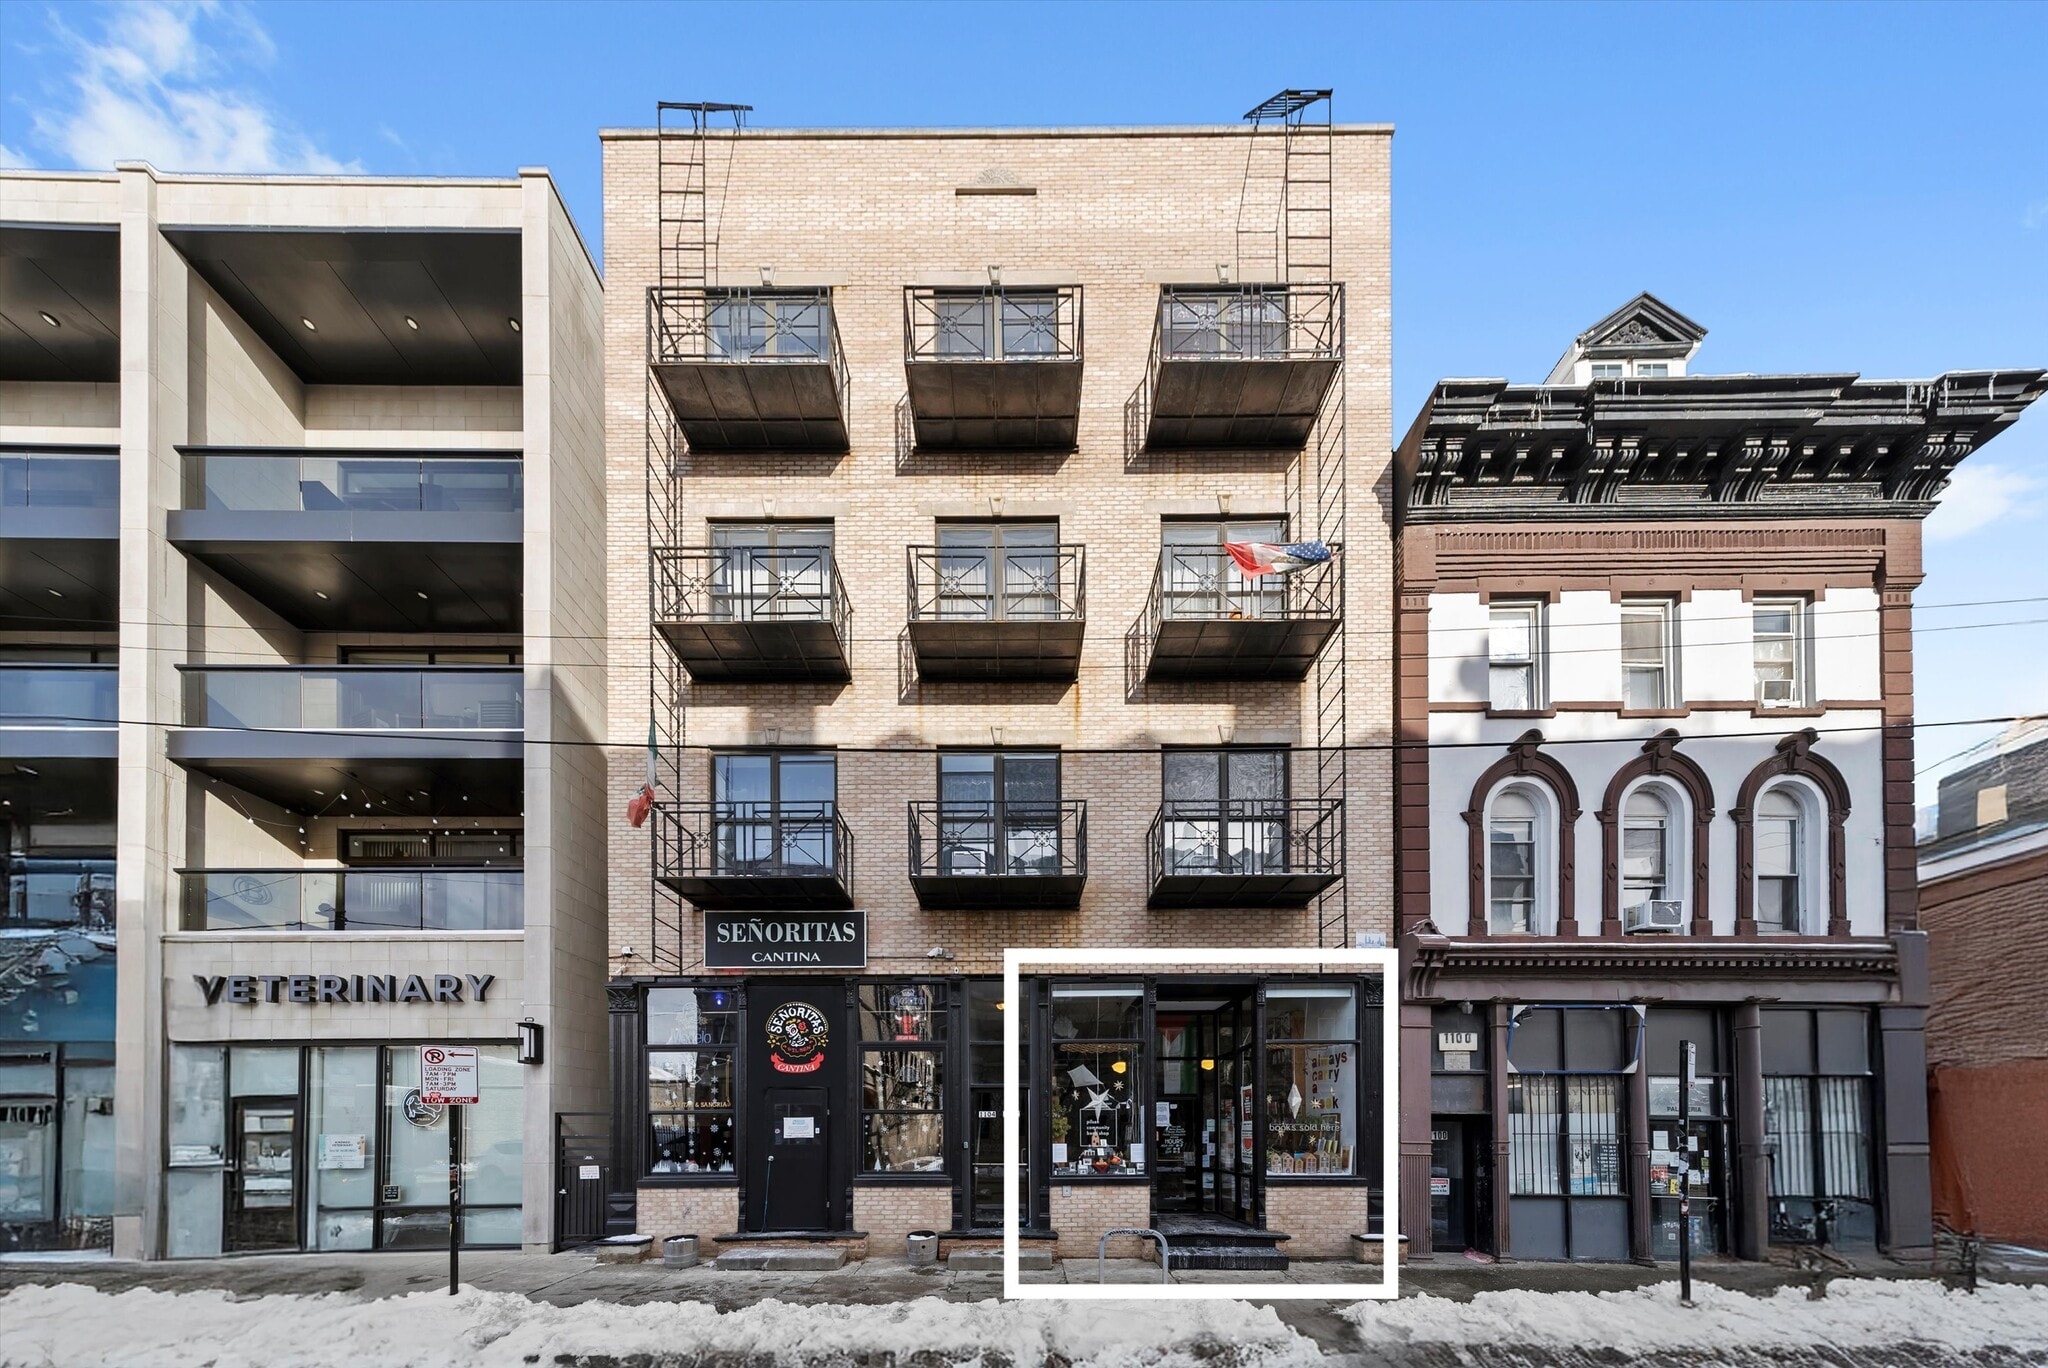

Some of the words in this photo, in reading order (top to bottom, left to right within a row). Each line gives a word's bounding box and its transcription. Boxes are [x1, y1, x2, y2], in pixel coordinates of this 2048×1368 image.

[717, 918, 856, 943] SEÑORITAS
[751, 952, 821, 962] CANTINA
[193, 974, 496, 1006] VETERINARY
[770, 1006, 824, 1034] SEÑORITAS
[1443, 1033, 1472, 1044] 1100
[1311, 1051, 1348, 1069] always
[777, 1064, 815, 1072] CANTINA
[1311, 1068, 1340, 1083] carry
[1312, 1083, 1318, 1094] a
[1269, 1123, 1296, 1131] books
[1300, 1123, 1317, 1131] sold
[1321, 1123, 1340, 1131] here
